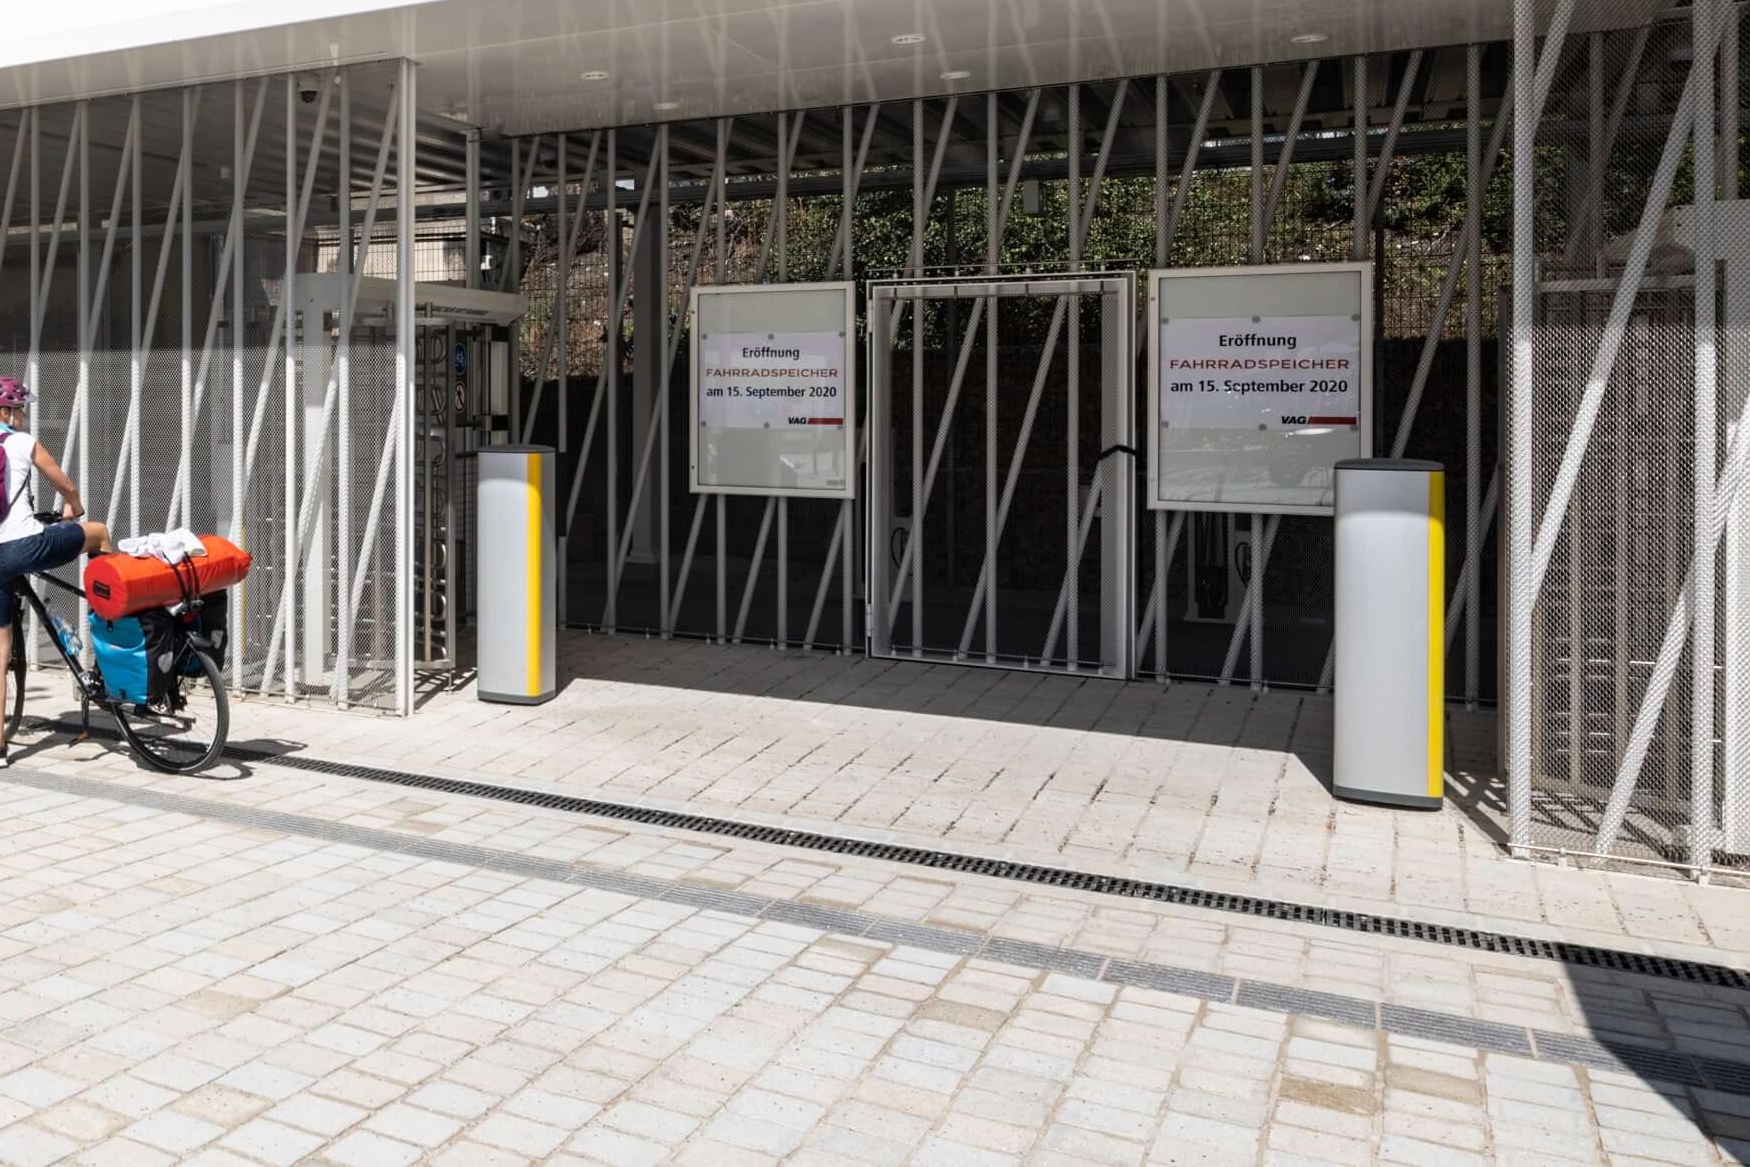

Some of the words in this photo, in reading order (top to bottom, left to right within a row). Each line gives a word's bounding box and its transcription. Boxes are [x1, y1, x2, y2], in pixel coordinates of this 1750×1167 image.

[1219, 334, 1297, 349] Eröffnung
[742, 347, 800, 360] Eröffnung
[1170, 359, 1349, 370] FAHRRADSPEICHER
[706, 369, 838, 378] FAHRRADSPEICHER
[706, 389, 723, 397] am
[728, 387, 742, 397] 15.
[746, 387, 806, 399] September
[809, 387, 837, 397] 2020
[1170, 382, 1193, 392] am
[1199, 381, 1219, 392] 15.
[1224, 380, 1305, 395] September
[1309, 380, 1348, 392] 2020
[788, 417, 807, 425] VAG
[1281, 416, 1307, 425] VAG
